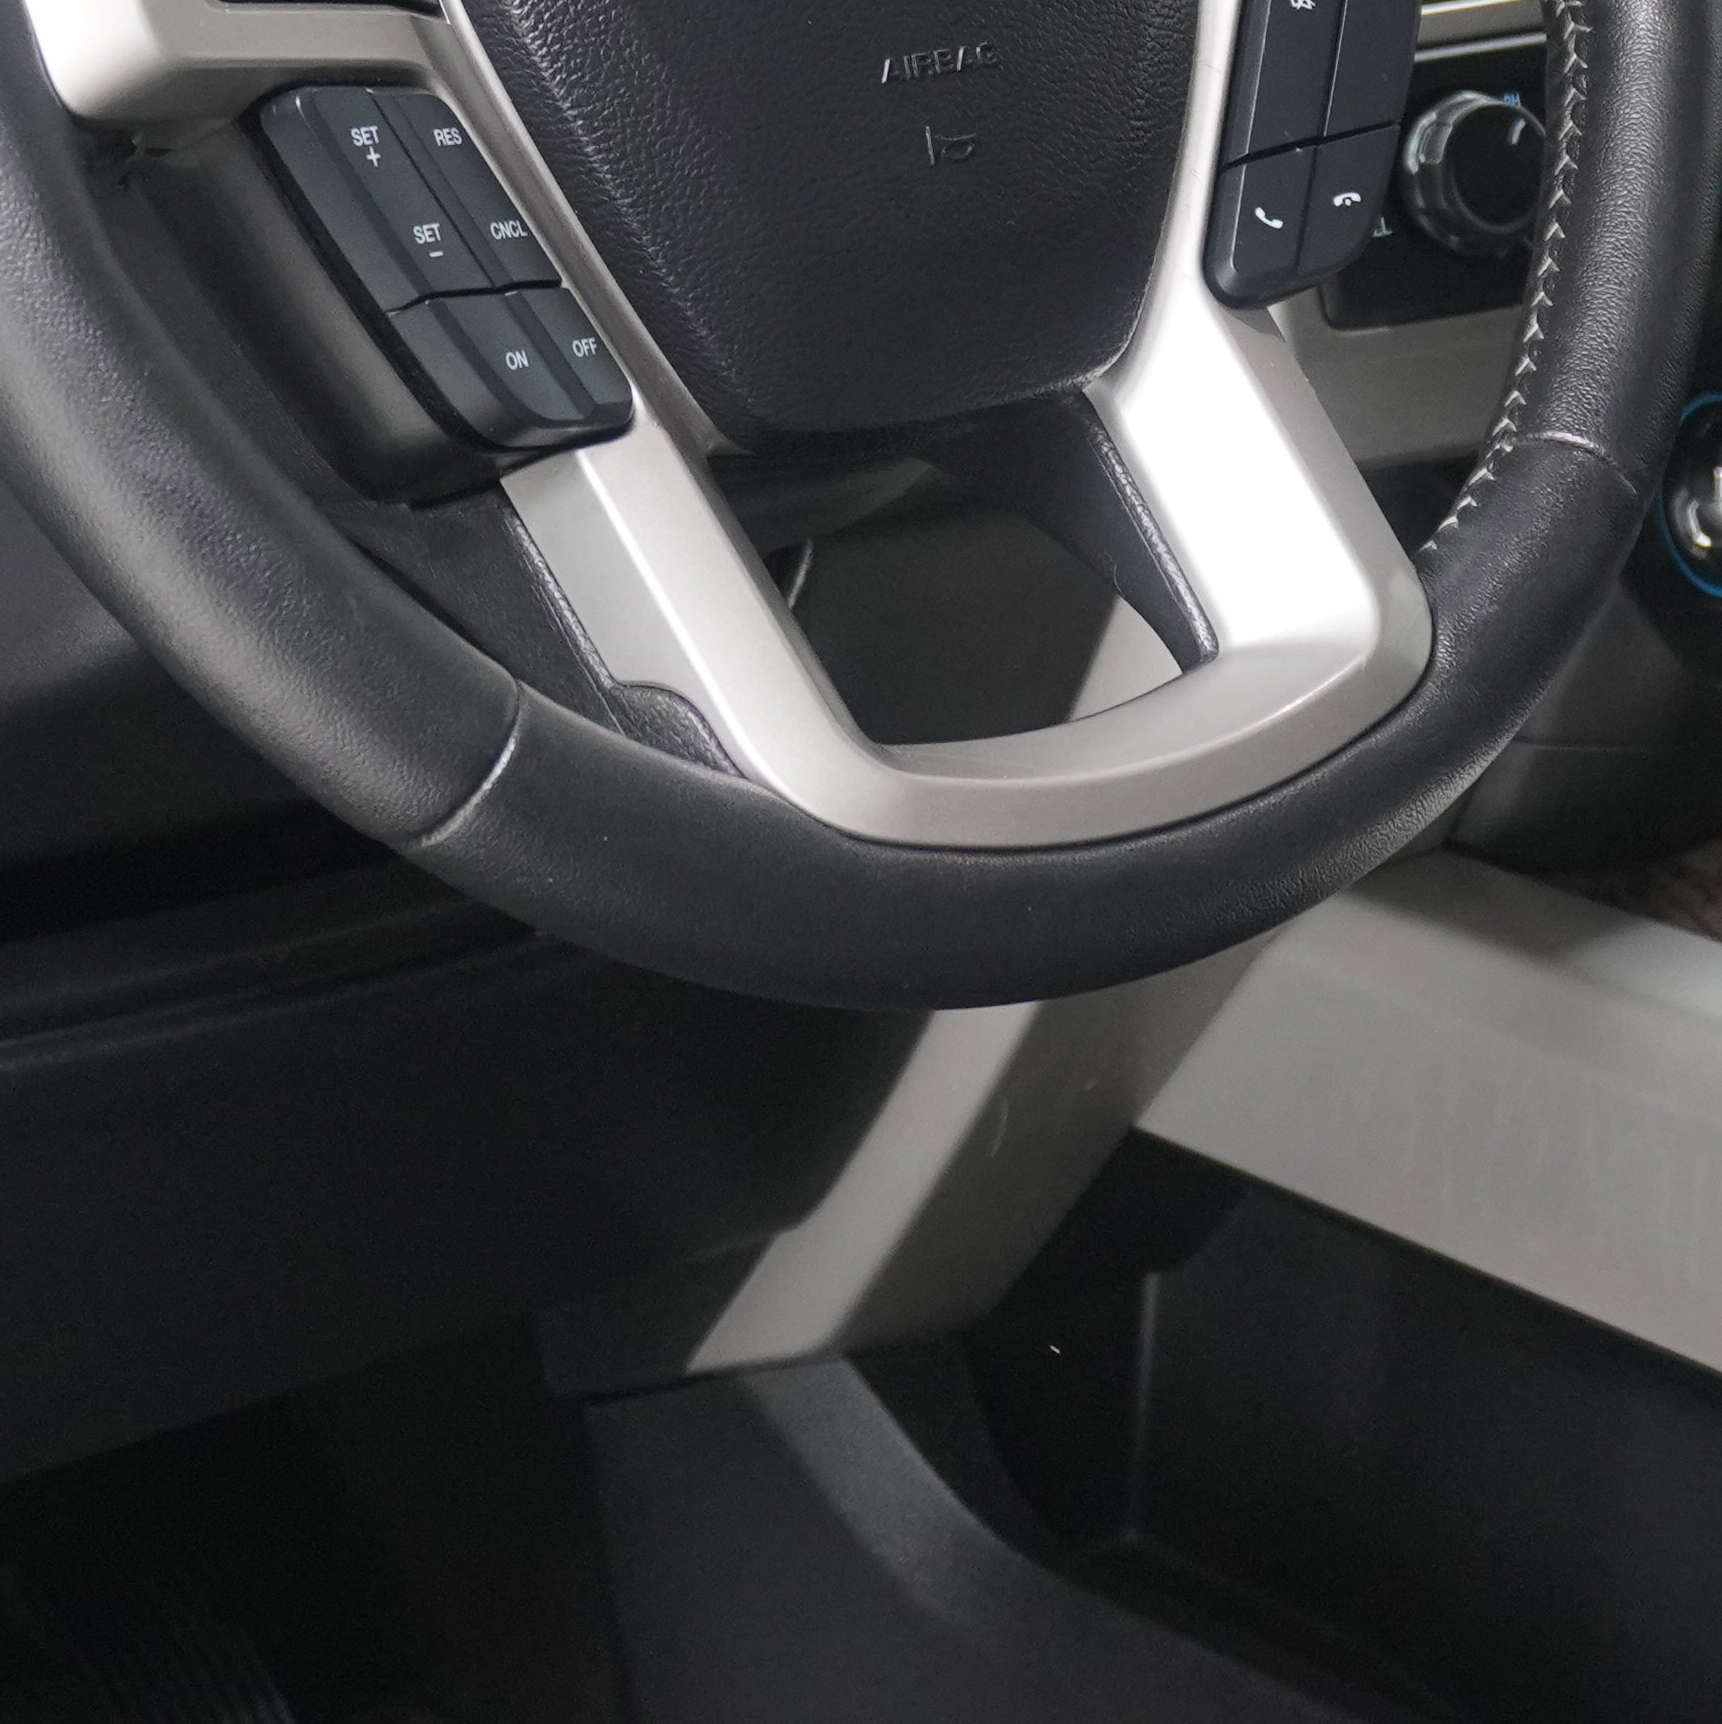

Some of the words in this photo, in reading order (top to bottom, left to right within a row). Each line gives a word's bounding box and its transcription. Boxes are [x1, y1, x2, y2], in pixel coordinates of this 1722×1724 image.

[881, 40, 1000, 84] AIRBAG
[350, 125, 379, 147] SET
[433, 127, 463, 146] RES
[413, 223, 441, 244] SET
[490, 220, 528, 240] CNCL
[572, 337, 597, 357] OFF
[506, 350, 528, 370] ON
